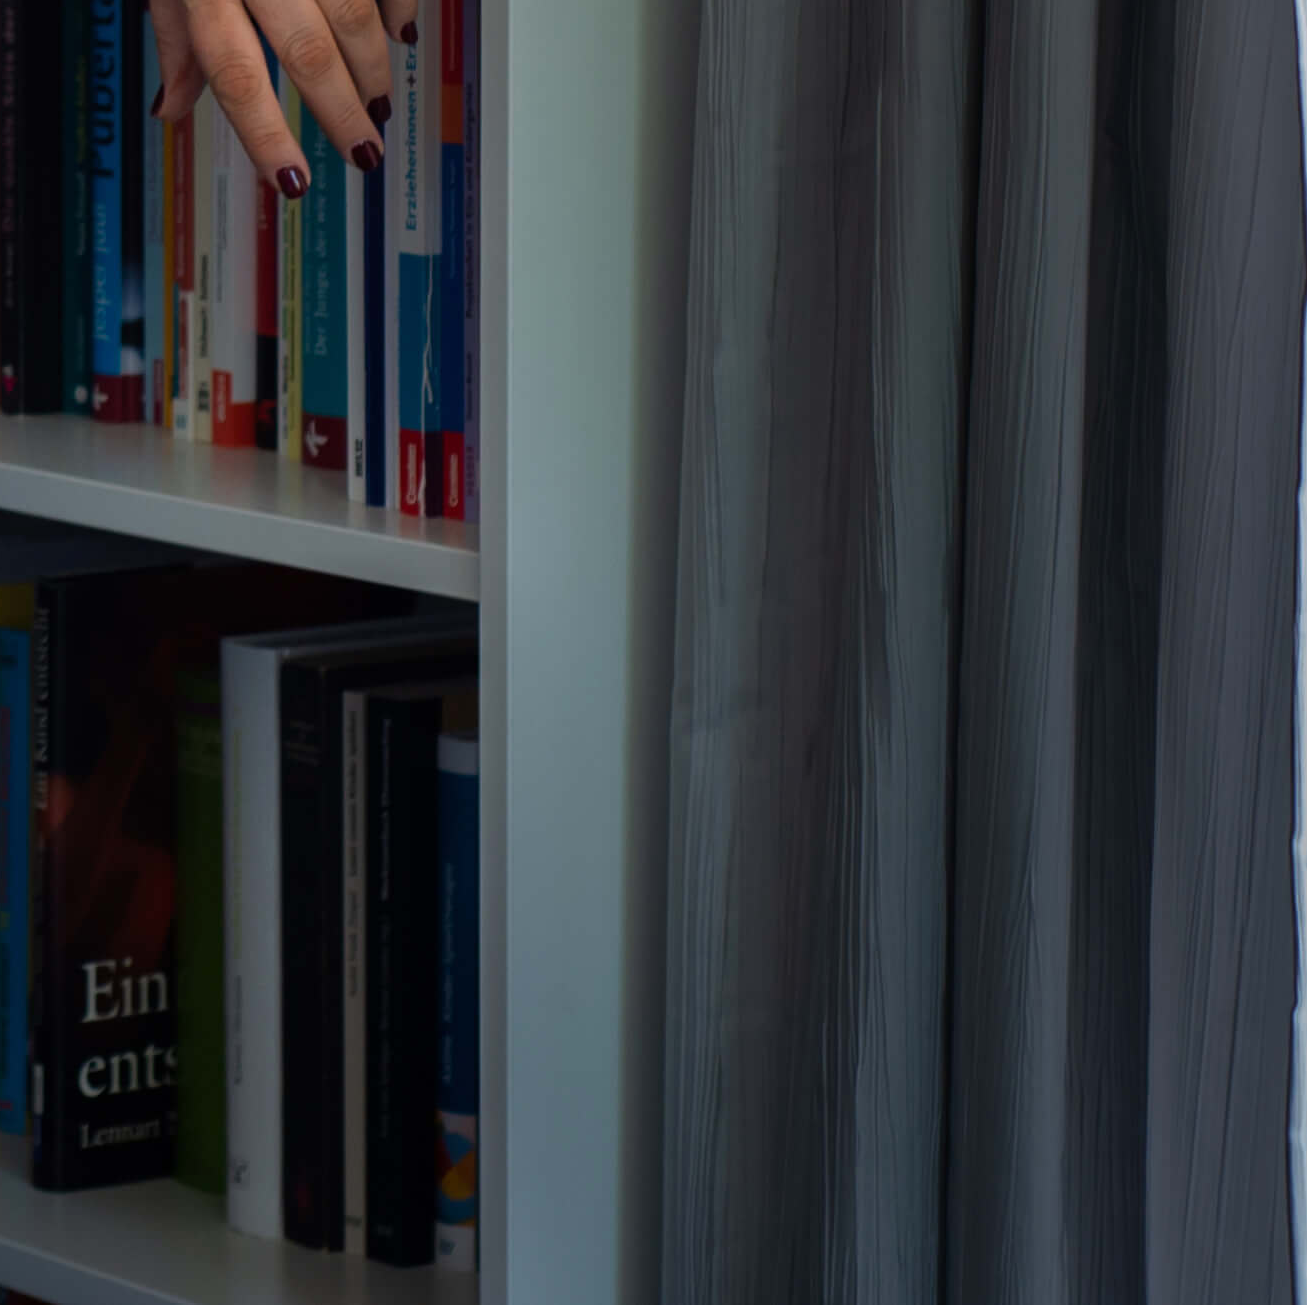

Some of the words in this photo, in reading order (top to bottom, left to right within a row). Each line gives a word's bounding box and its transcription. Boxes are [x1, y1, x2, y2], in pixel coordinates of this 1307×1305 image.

[405, 89, 418, 232] Erzieherinnen
[80, 955, 169, 1024] Ein
[80, 1114, 162, 1150] Lennart
